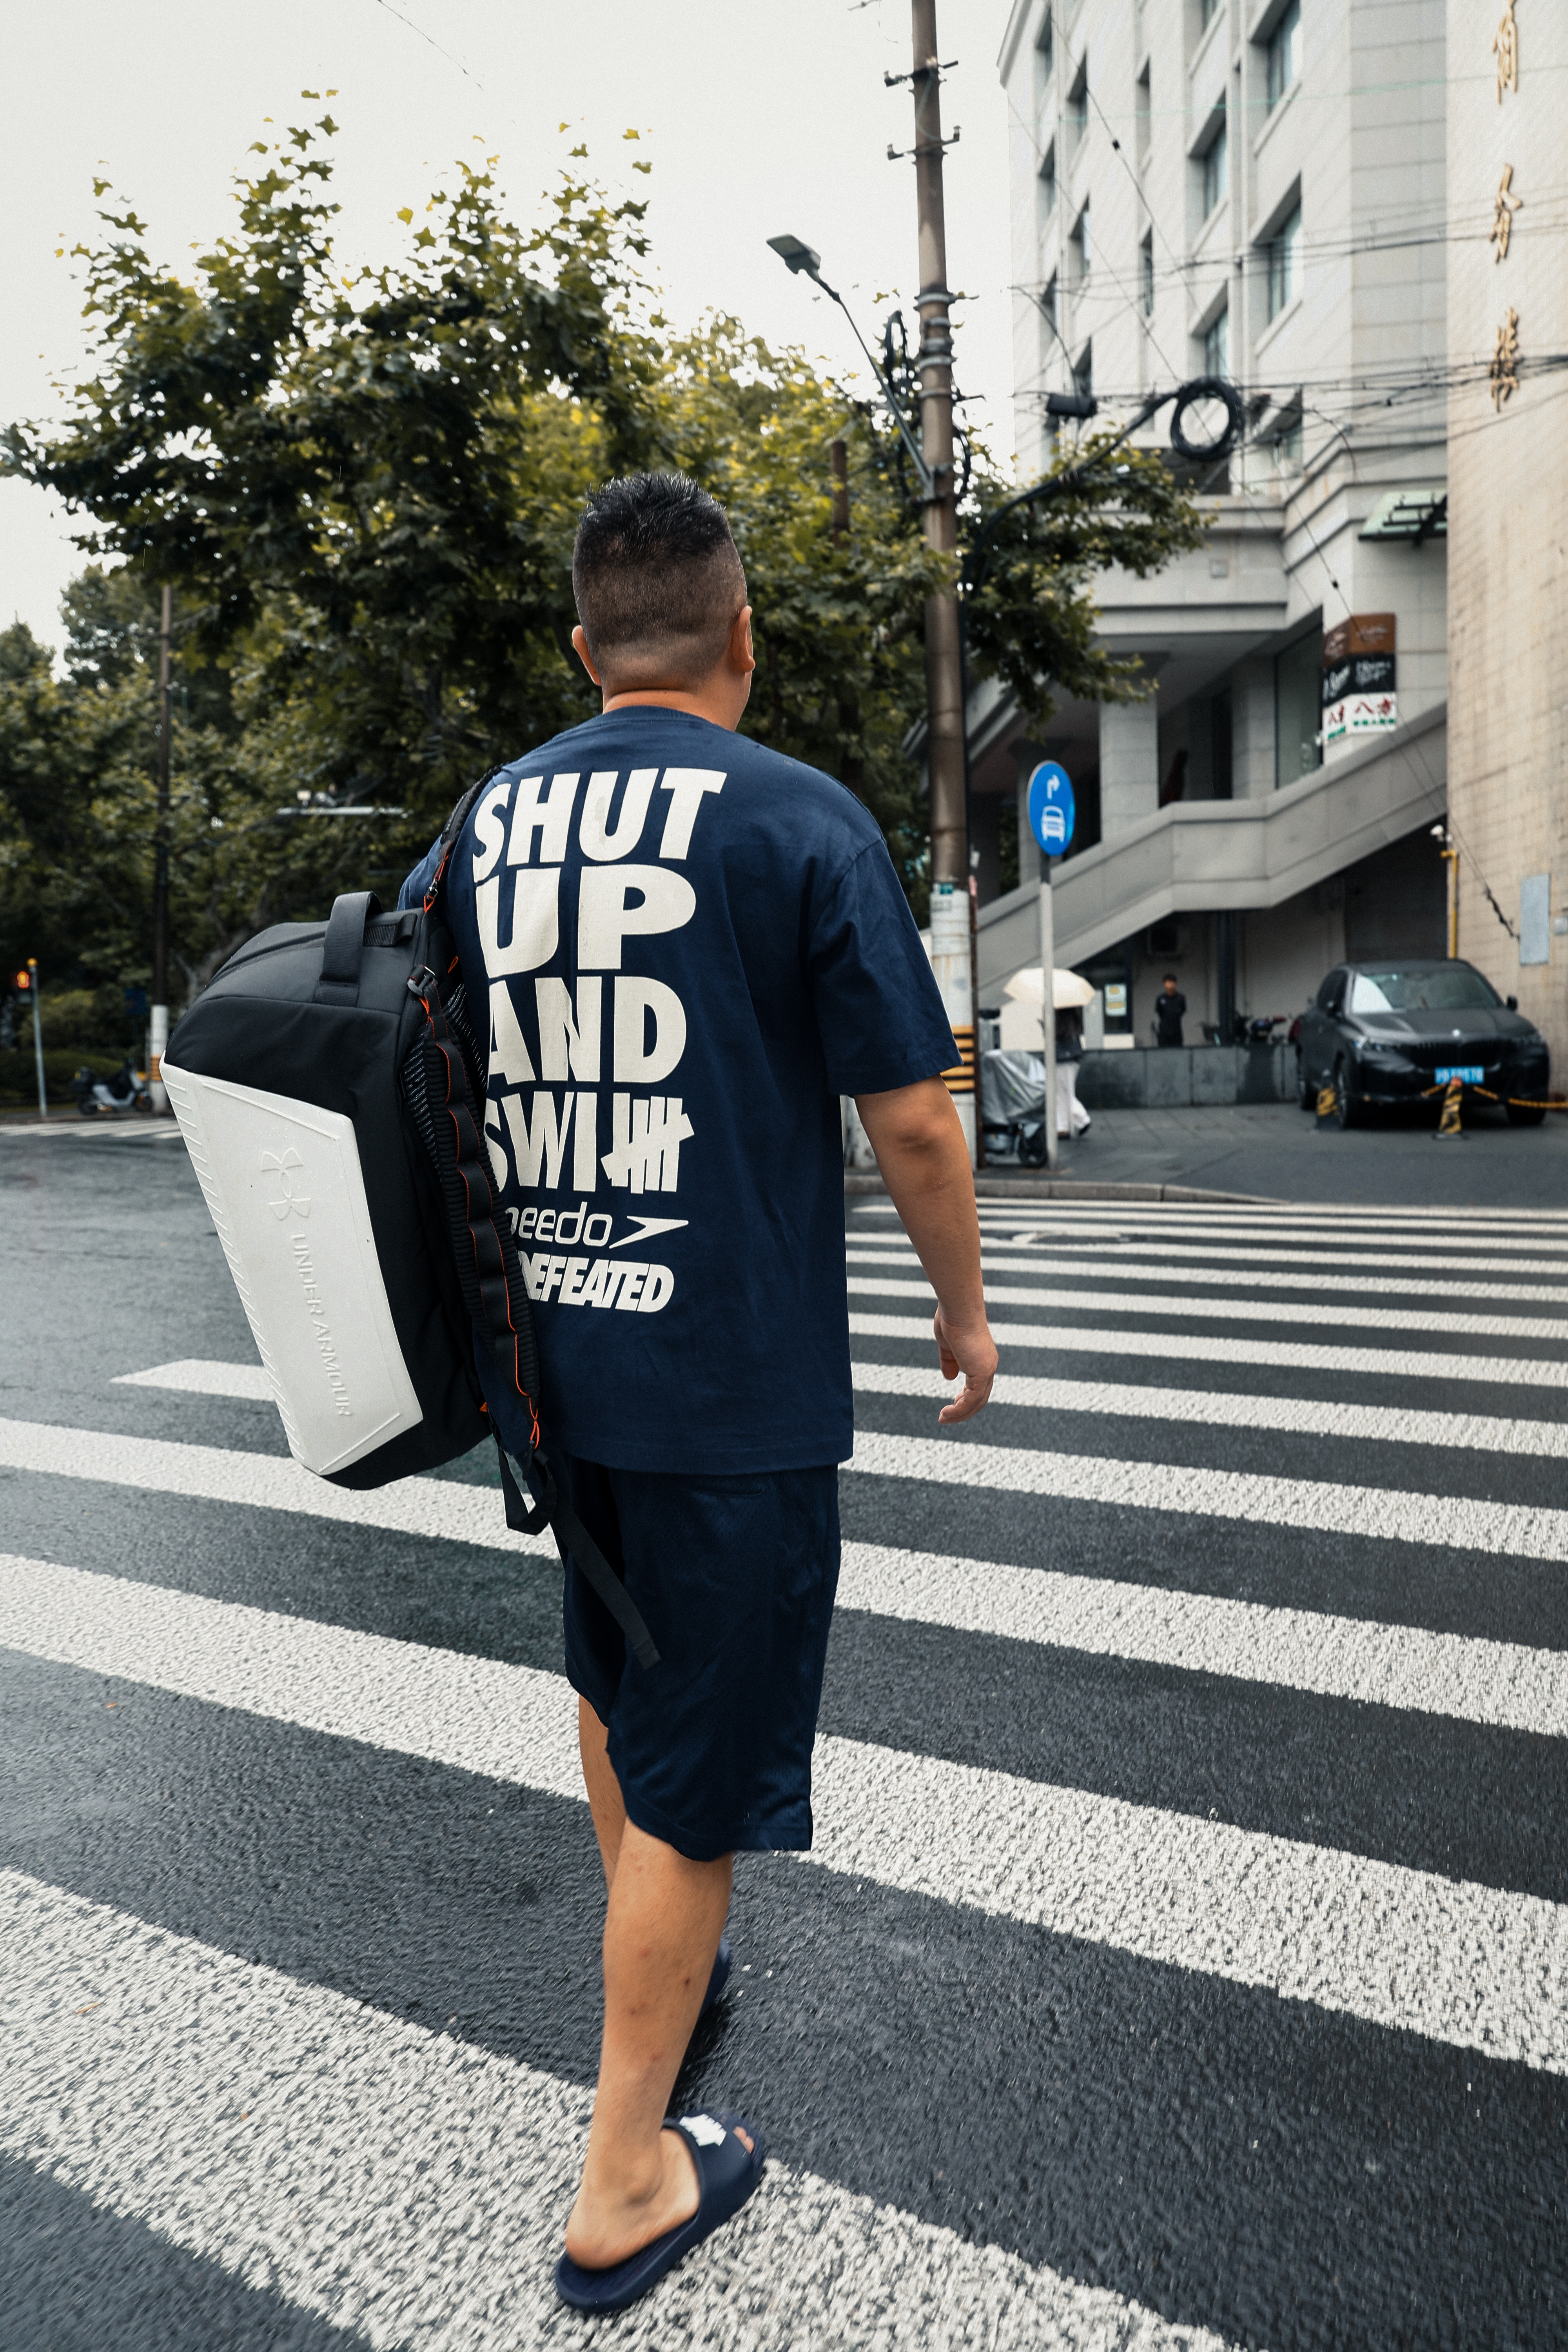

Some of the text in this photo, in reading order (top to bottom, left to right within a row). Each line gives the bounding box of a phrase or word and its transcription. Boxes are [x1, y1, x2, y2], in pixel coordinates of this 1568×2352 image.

[473, 767, 727, 883] SHUT
[475, 864, 696, 979] UP
[489, 976, 686, 1085] AND
[291, 1233, 354, 1416] UNDER ARMOUR
